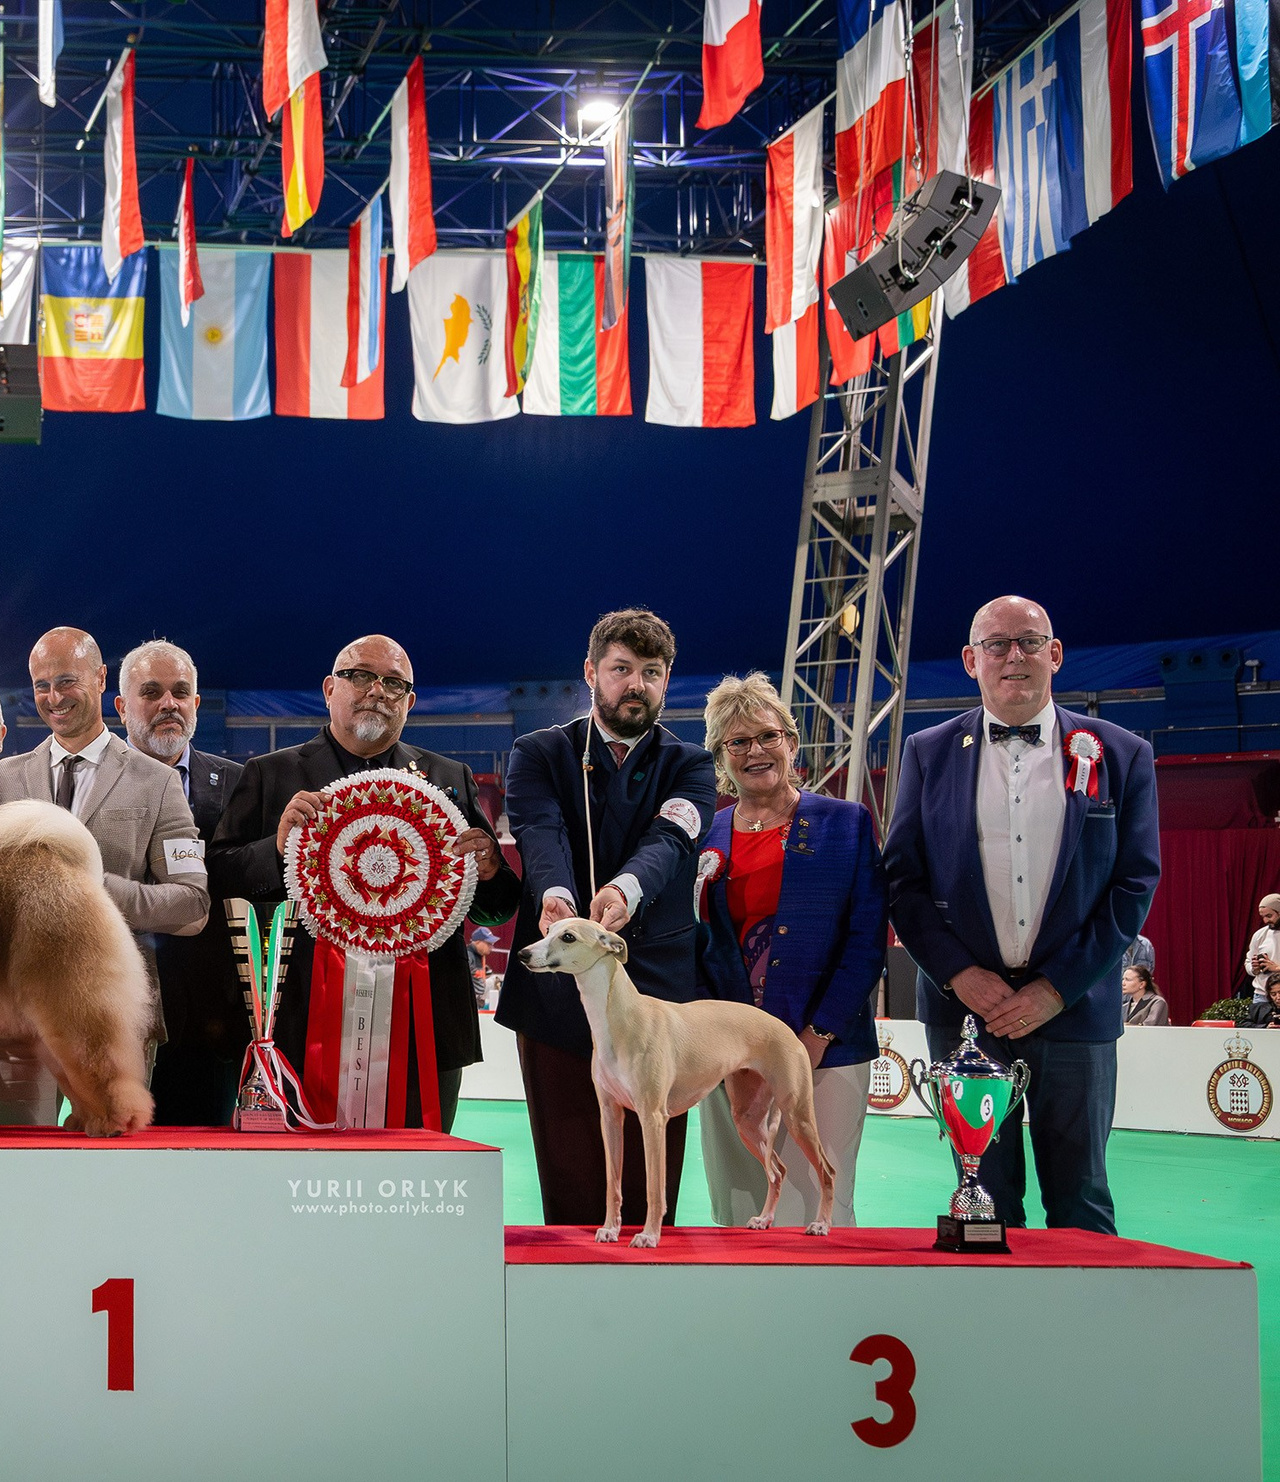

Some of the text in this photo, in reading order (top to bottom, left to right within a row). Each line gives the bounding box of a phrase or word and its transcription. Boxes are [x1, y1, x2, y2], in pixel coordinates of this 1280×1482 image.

[353, 1016, 366, 1091] BEST
[91, 1278, 135, 1391] 1
[849, 1333, 917, 1449] 3
